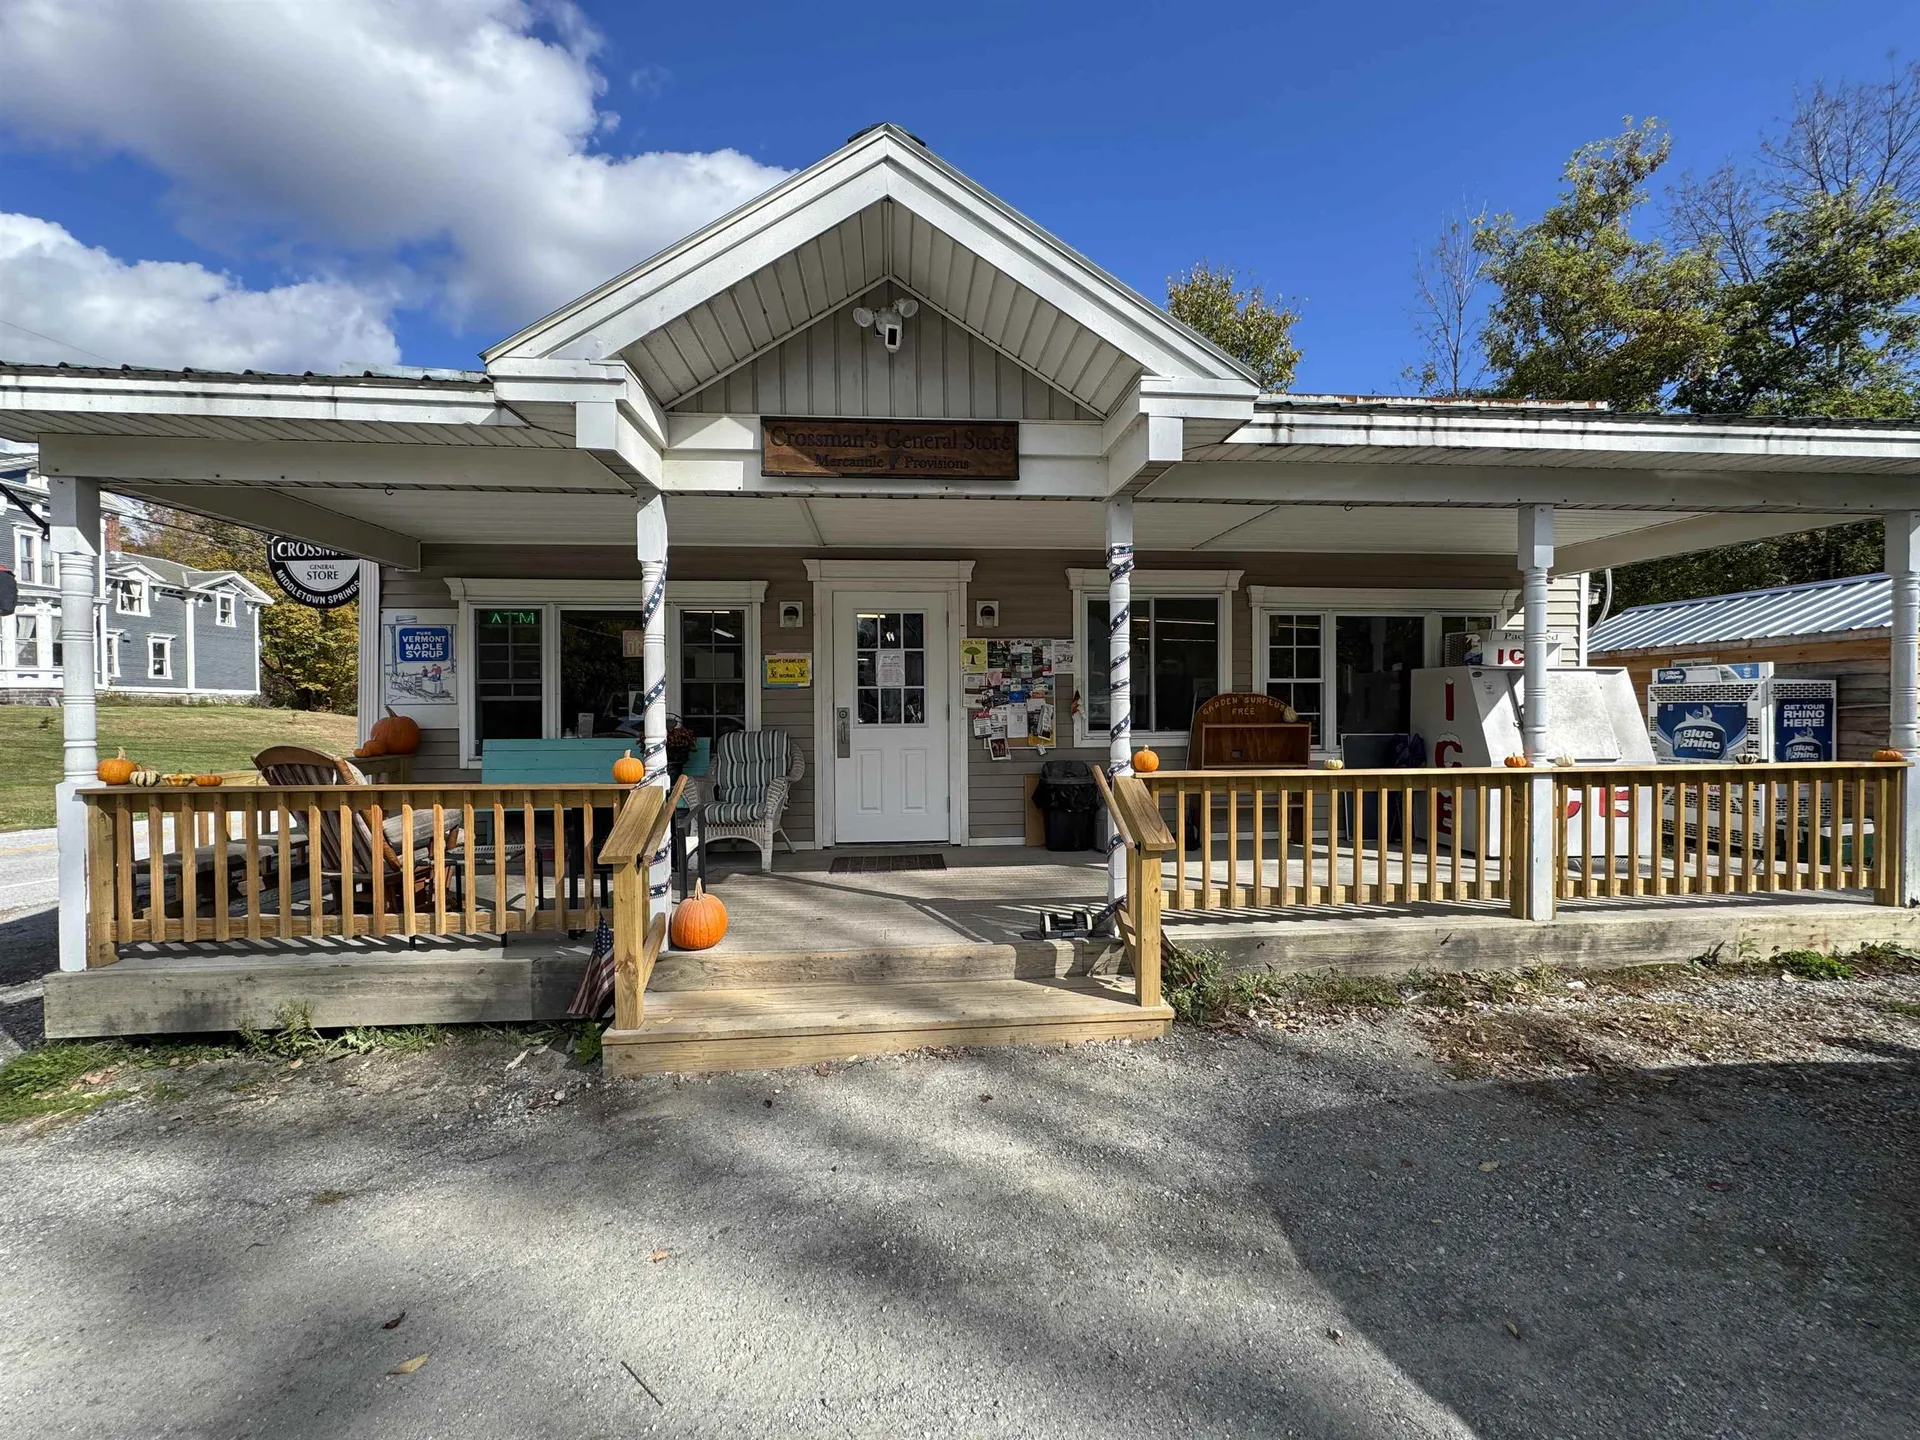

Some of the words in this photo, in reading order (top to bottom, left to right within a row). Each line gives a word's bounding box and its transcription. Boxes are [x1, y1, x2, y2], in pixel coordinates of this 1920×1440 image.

[770, 426, 878, 448] Crossman's
[884, 428, 957, 450] General
[963, 430, 1011, 451] Store
[814, 453, 884, 468] Mercantile
[903, 455, 970, 469] Provisions
[306, 570, 339, 580] STORE
[276, 569, 326, 605] MIDDLETOWN
[327, 579, 360, 604] SPRINGS
[491, 612, 534, 624] ATM
[1504, 632, 1558, 641] Paced
[405, 643, 443, 651] MAPLE
[1497, 649, 1524, 665] IC
[1202, 698, 1238, 715] GARDEN
[1783, 710, 1825, 718] RHINO
[1783, 719, 1825, 727] HERE!
[1683, 729, 1714, 738] Blue
